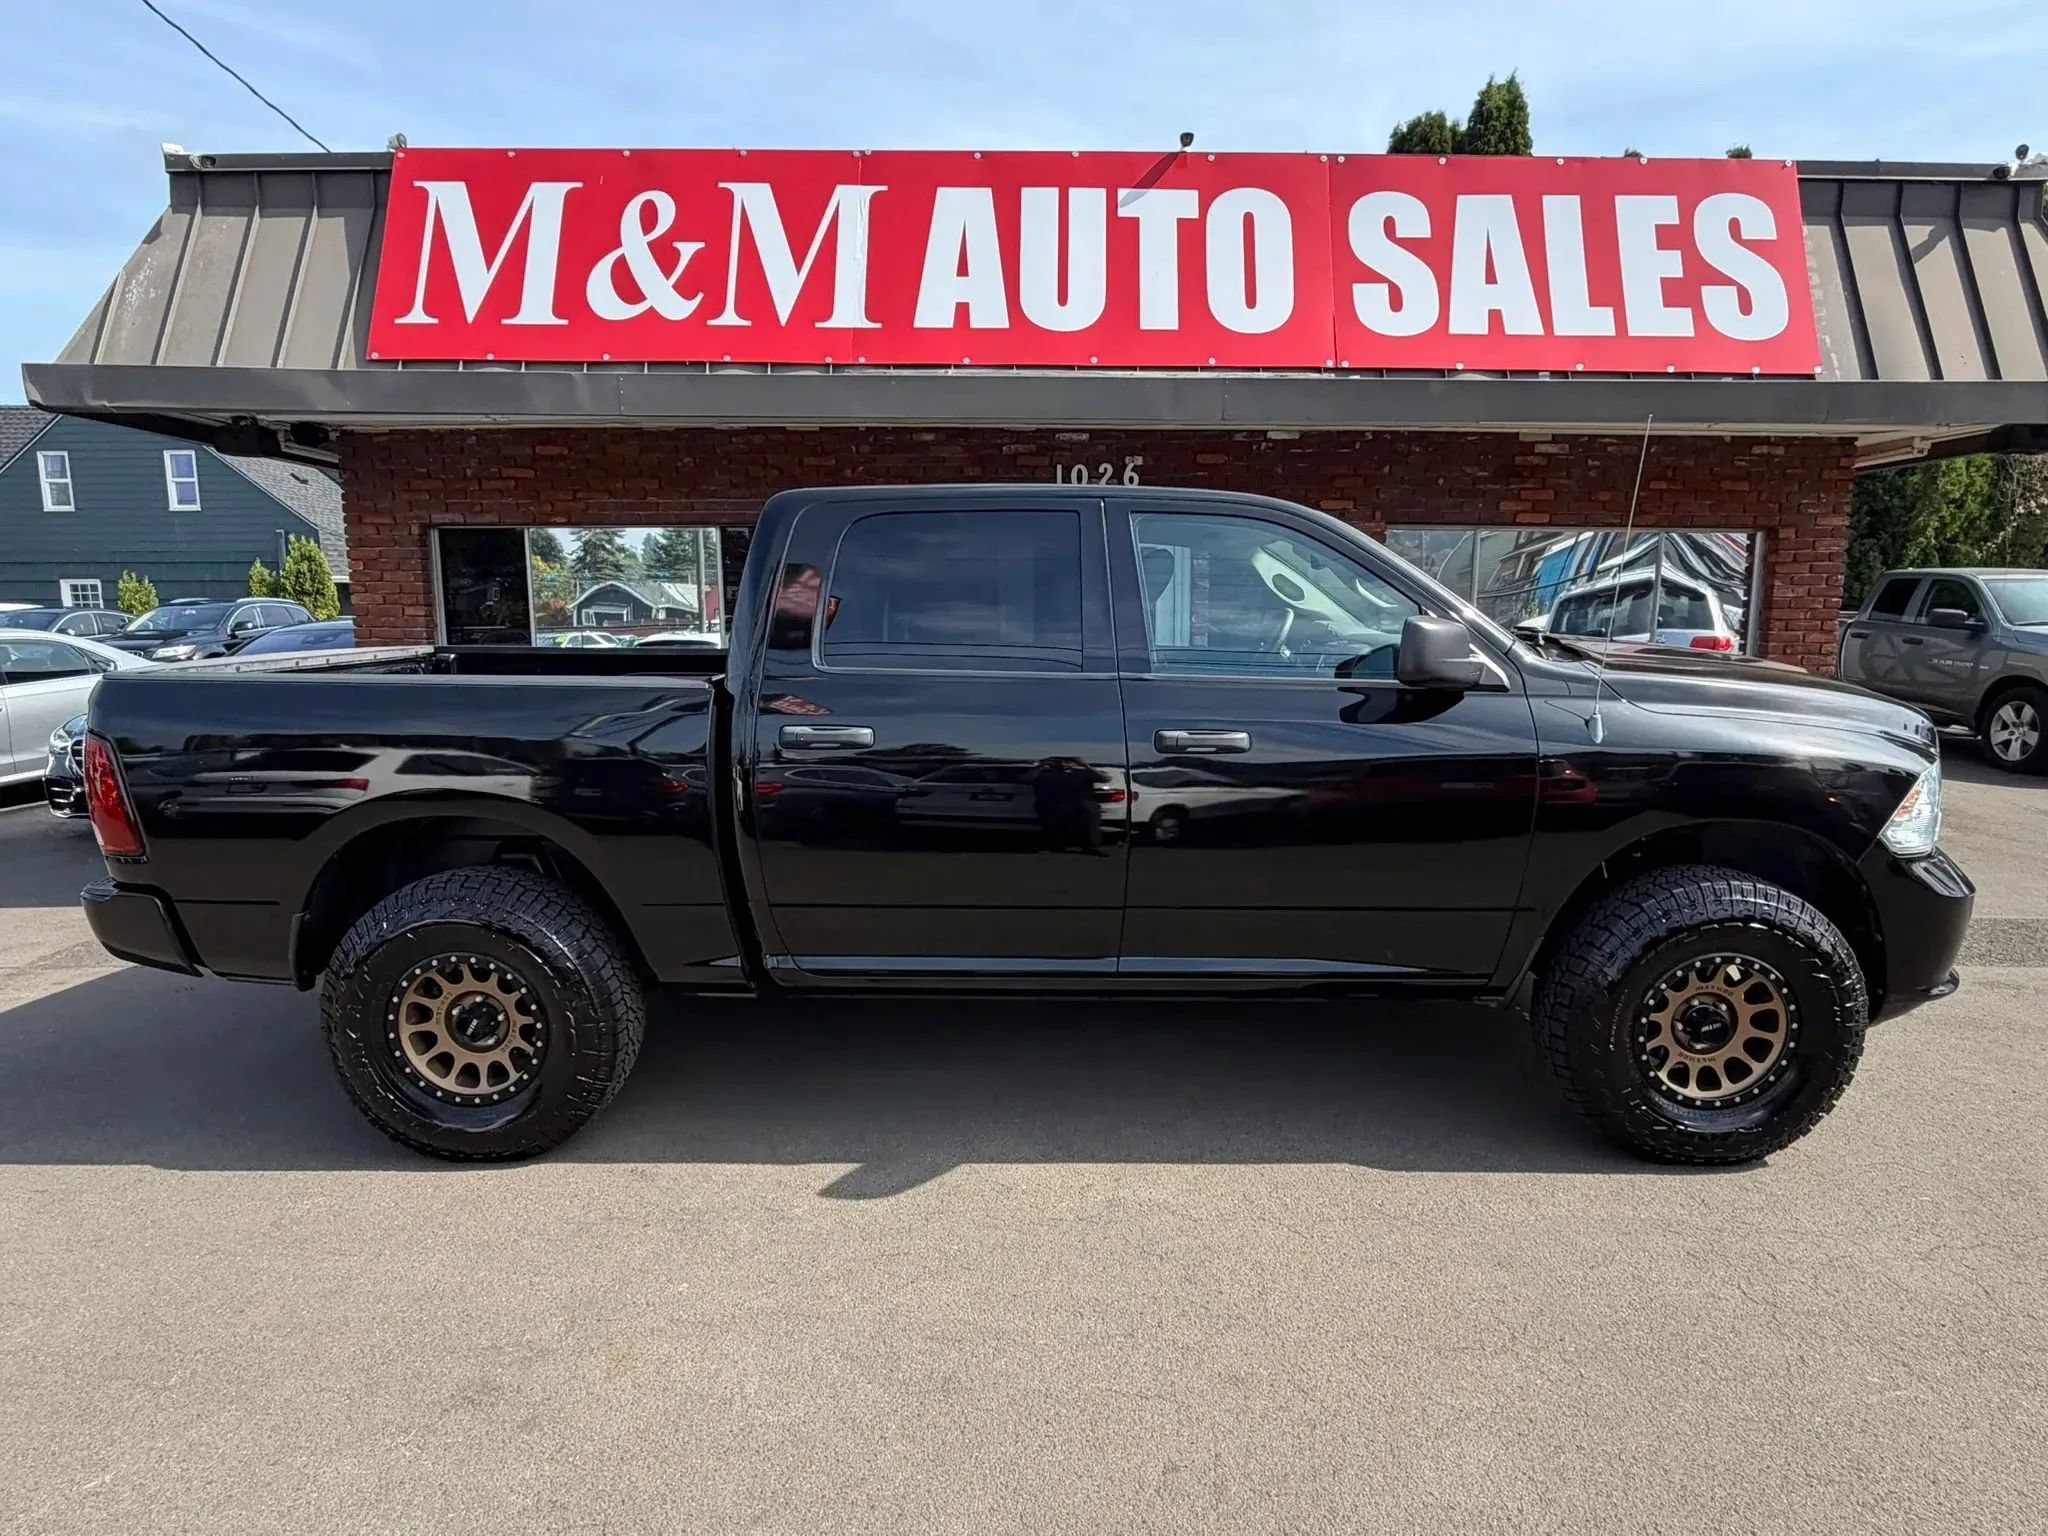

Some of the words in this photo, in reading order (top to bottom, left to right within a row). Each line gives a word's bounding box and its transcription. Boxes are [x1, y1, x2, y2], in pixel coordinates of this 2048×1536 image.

[394, 181, 888, 328] M&M
[913, 187, 1295, 334] AUTO
[1348, 191, 1790, 341] SALES
[1056, 462, 1140, 487] 1026
